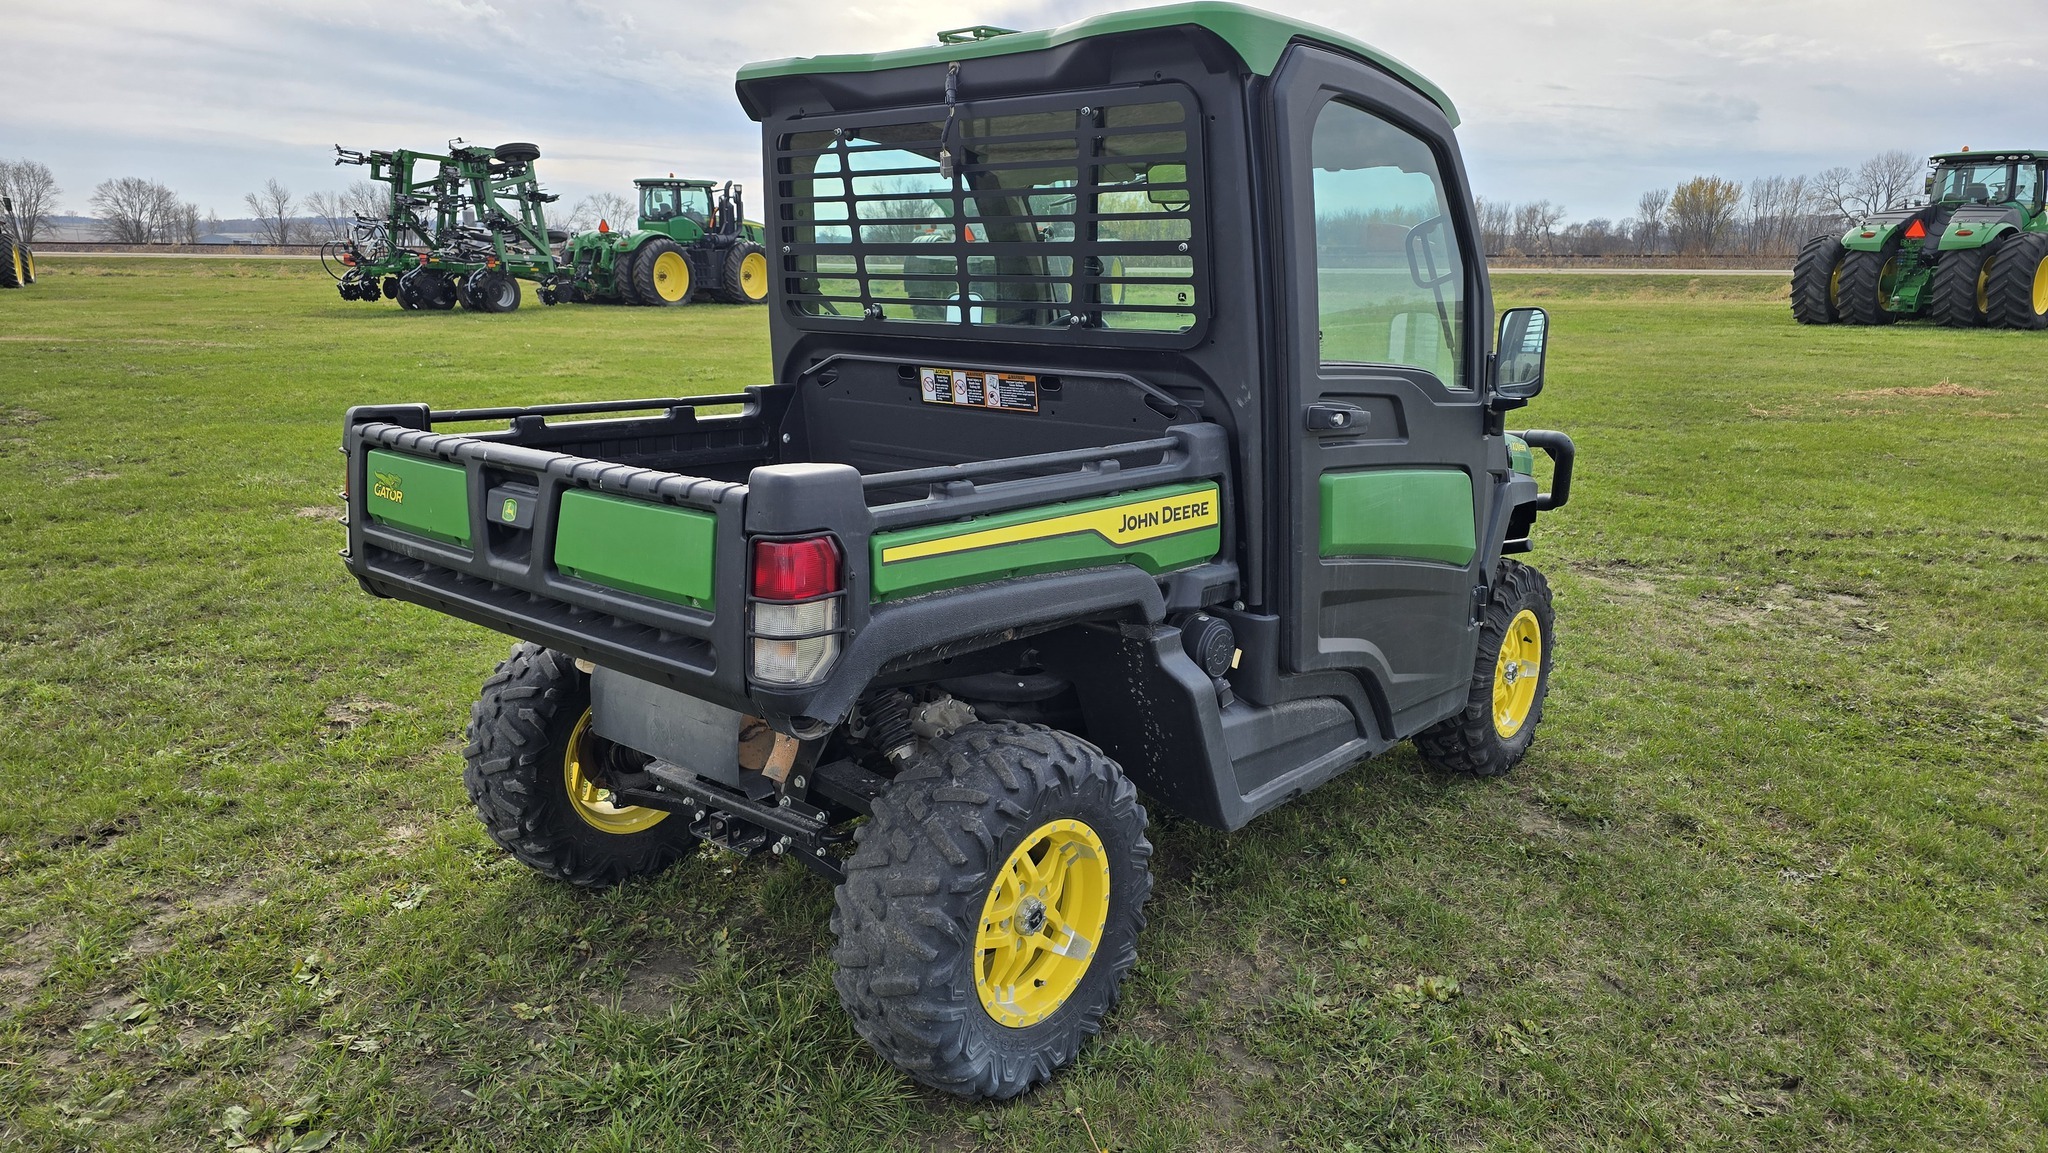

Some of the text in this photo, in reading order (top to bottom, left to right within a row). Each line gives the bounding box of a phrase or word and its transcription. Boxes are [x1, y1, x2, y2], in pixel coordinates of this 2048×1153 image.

[374, 483, 403, 503] GATOR
[1118, 501, 1209, 533] JOHN DEERE
